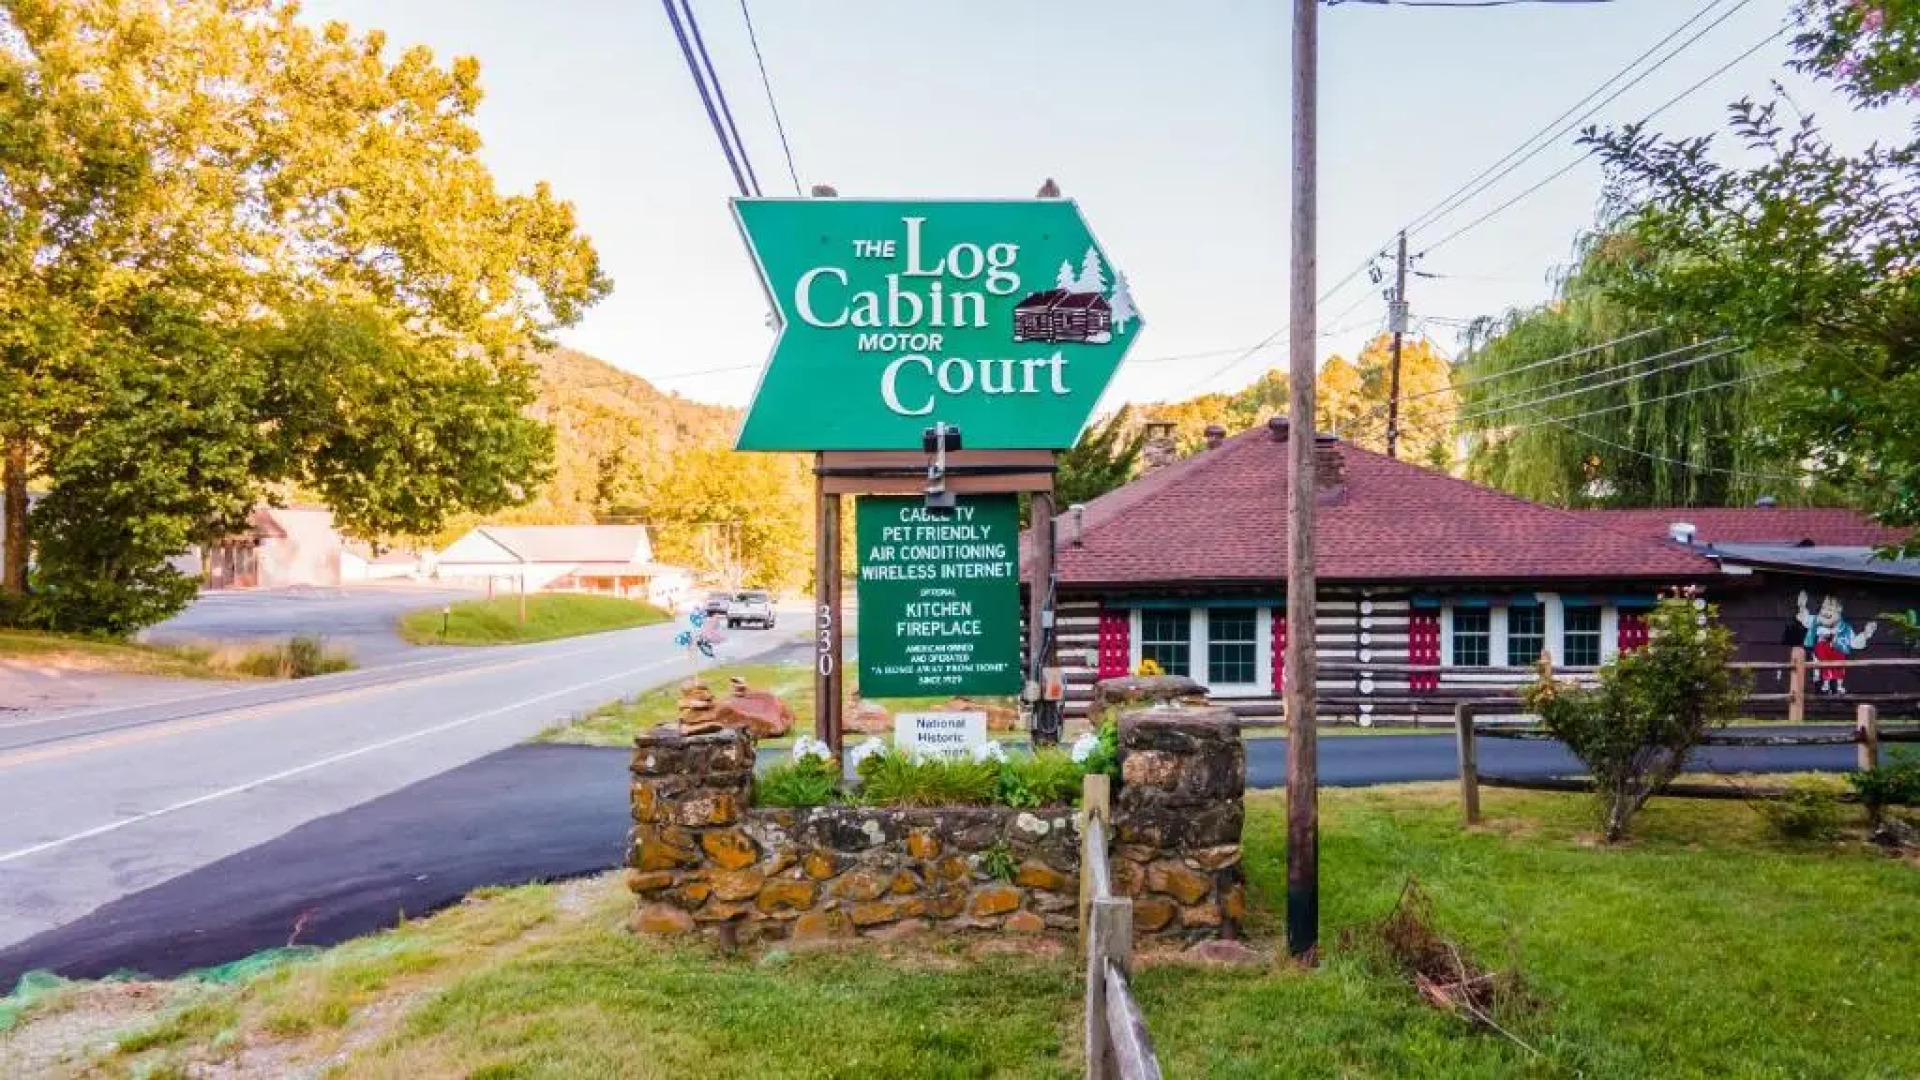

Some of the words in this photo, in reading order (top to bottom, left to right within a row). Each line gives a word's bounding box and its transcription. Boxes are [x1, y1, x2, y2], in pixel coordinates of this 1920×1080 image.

[852, 239, 897, 258] THE
[902, 216, 1021, 295] Log
[794, 266, 989, 328] Cabin
[858, 333, 944, 351] MOTOR
[880, 351, 1071, 415] Court
[955, 507, 974, 521] TV
[883, 527, 912, 541] PET
[916, 525, 990, 541] FRIENDLY
[870, 546, 895, 560] AIR
[901, 544, 1006, 560] CONDITIONING
[862, 564, 937, 580] WIRELESS
[941, 562, 1013, 578] INTERNET
[906, 602, 972, 617] KITCHEN
[897, 620, 982, 636] FIREPLACE
[819, 605, 833, 676] 330
[906, 645, 945, 653] AMERICAN
[911, 655, 927, 663] AND
[930, 653, 970, 662] OPERATED
[947, 664, 974, 672] FROM
[916, 718, 966, 729] National
[918, 733, 966, 743] Historic
